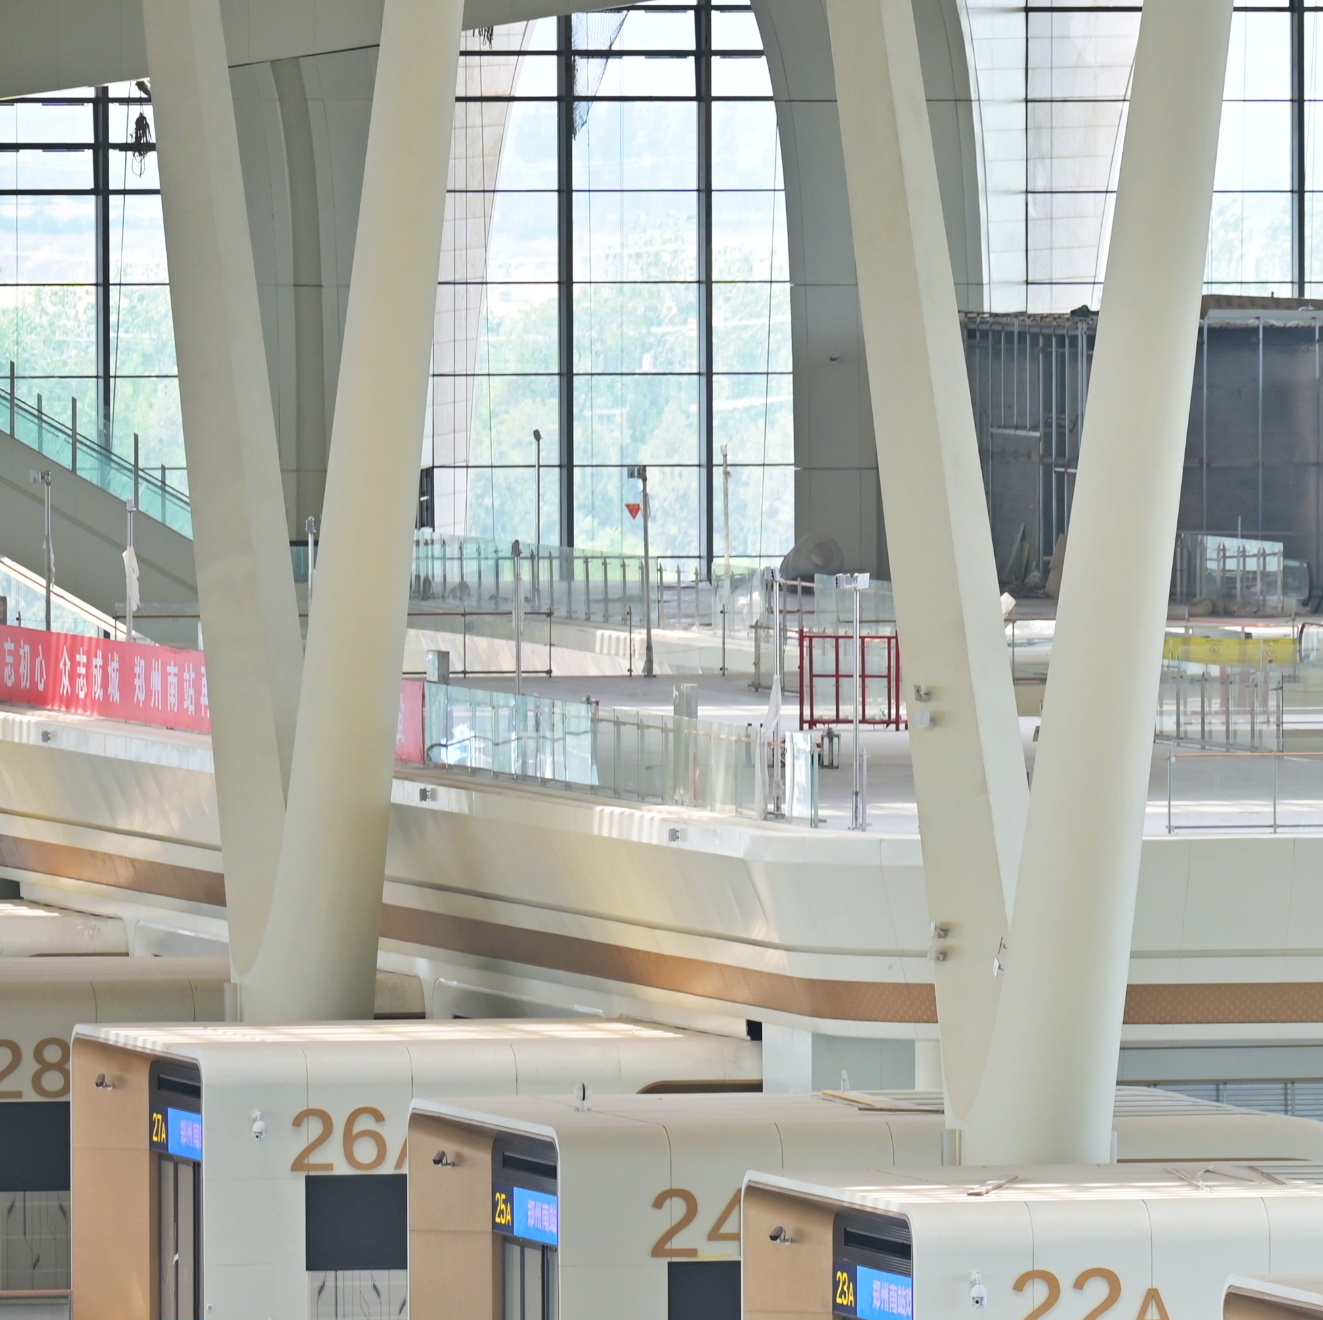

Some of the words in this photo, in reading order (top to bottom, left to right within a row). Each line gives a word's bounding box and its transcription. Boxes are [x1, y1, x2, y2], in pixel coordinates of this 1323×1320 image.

[3, 638, 46, 692] 忘初心
[59, 644, 120, 705] 众志成城
[152, 1112, 167, 1144] 27A
[290, 1106, 408, 1172] 26
[495, 1192, 512, 1226] 25A
[650, 1187, 742, 1258] 24
[836, 1270, 855, 1308] 23A
